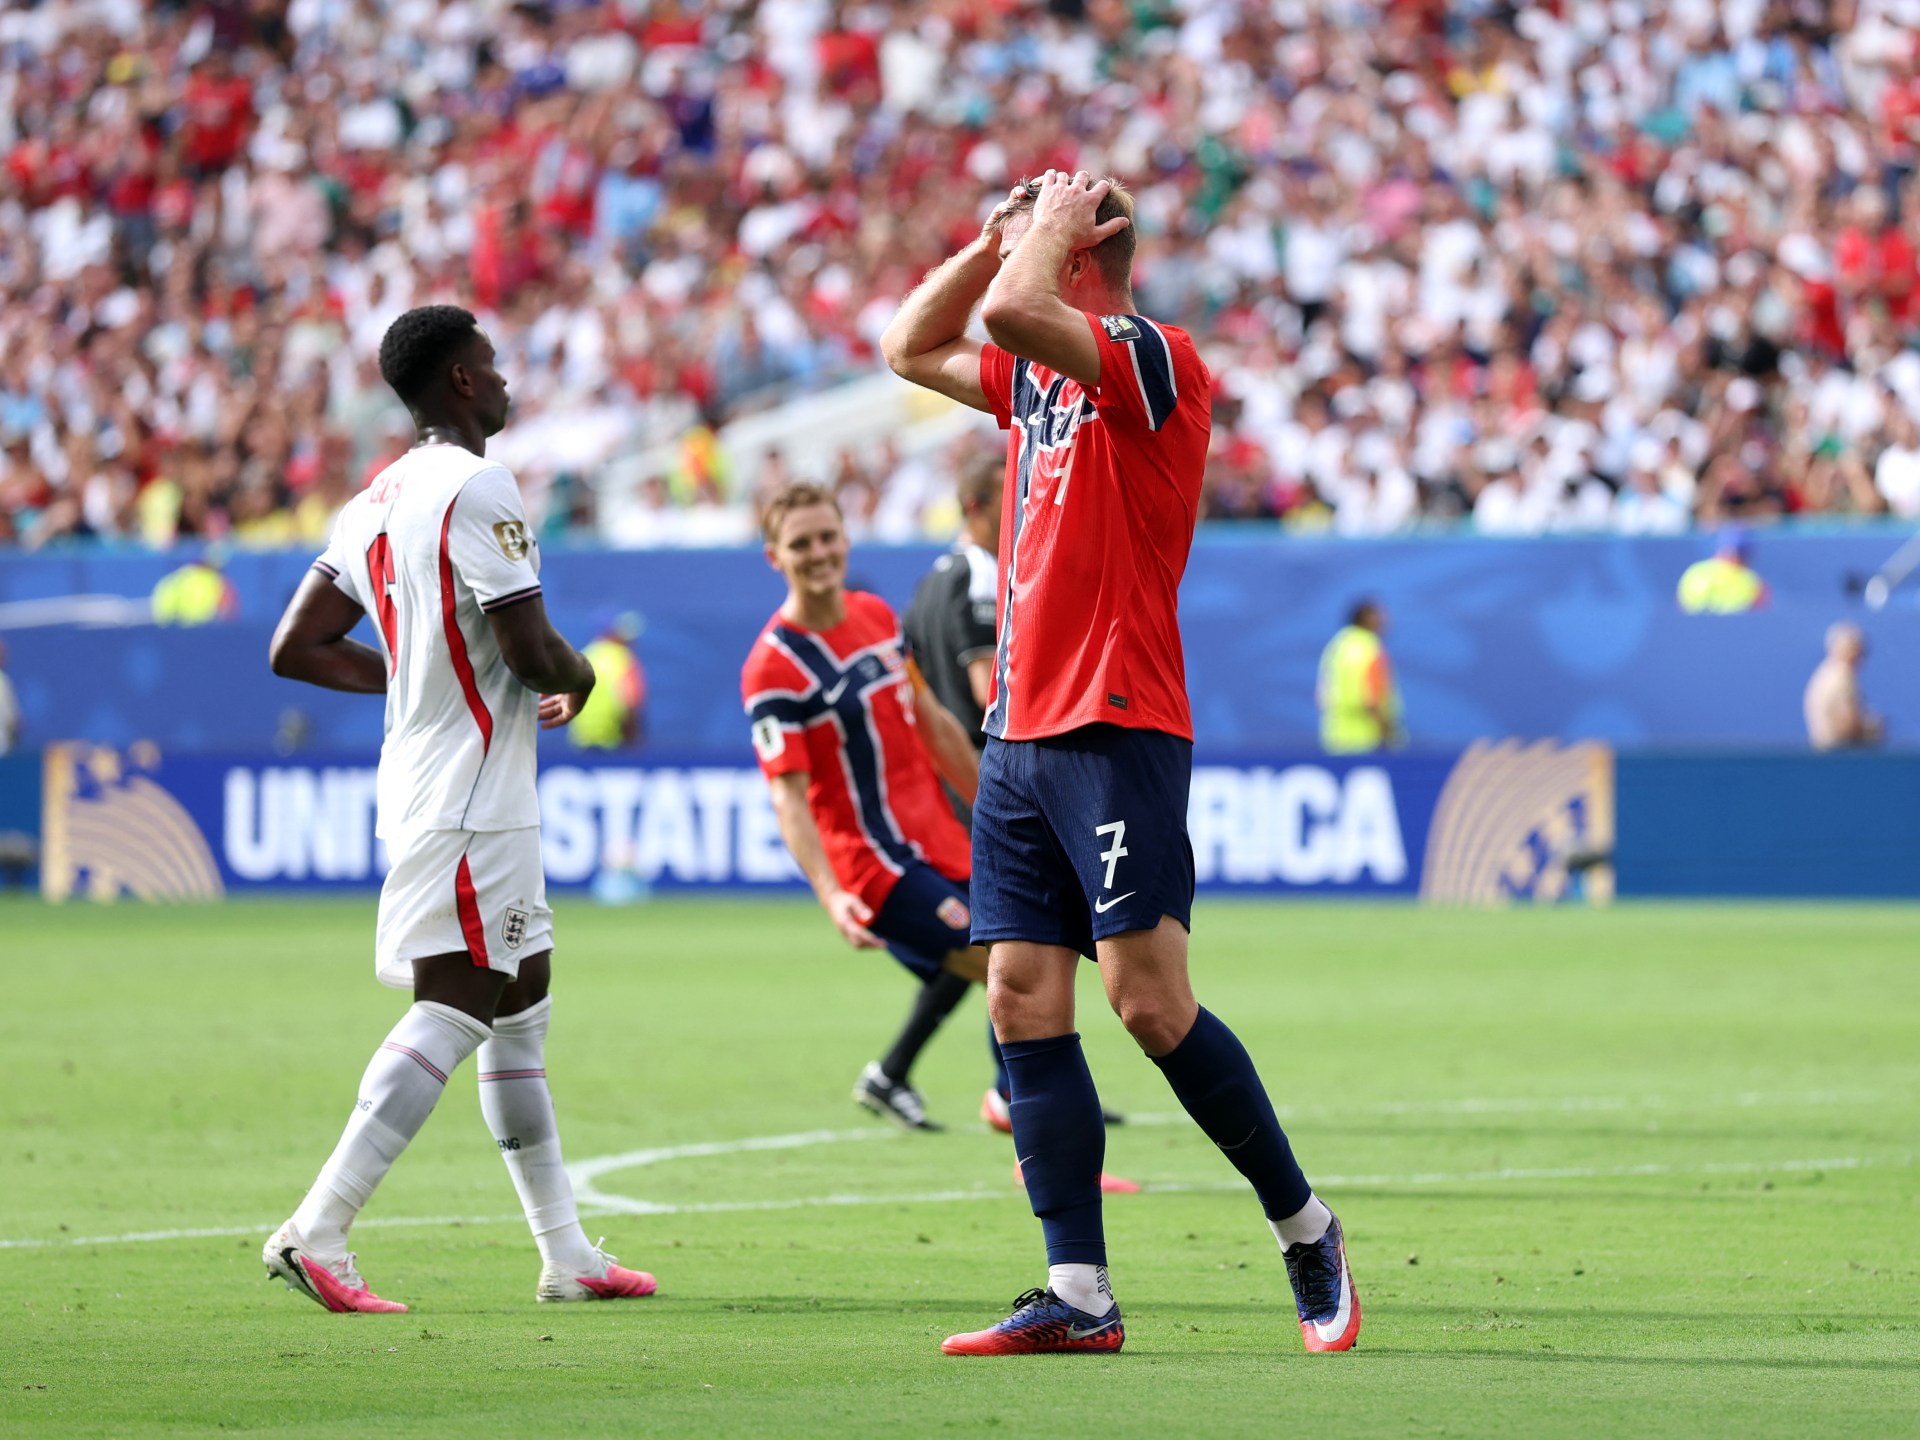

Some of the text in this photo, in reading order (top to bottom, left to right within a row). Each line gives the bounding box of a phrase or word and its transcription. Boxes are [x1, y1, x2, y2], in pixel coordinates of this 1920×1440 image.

[225, 765, 1408, 883] UNI STATE RICA
[1095, 819, 1128, 889] 7
